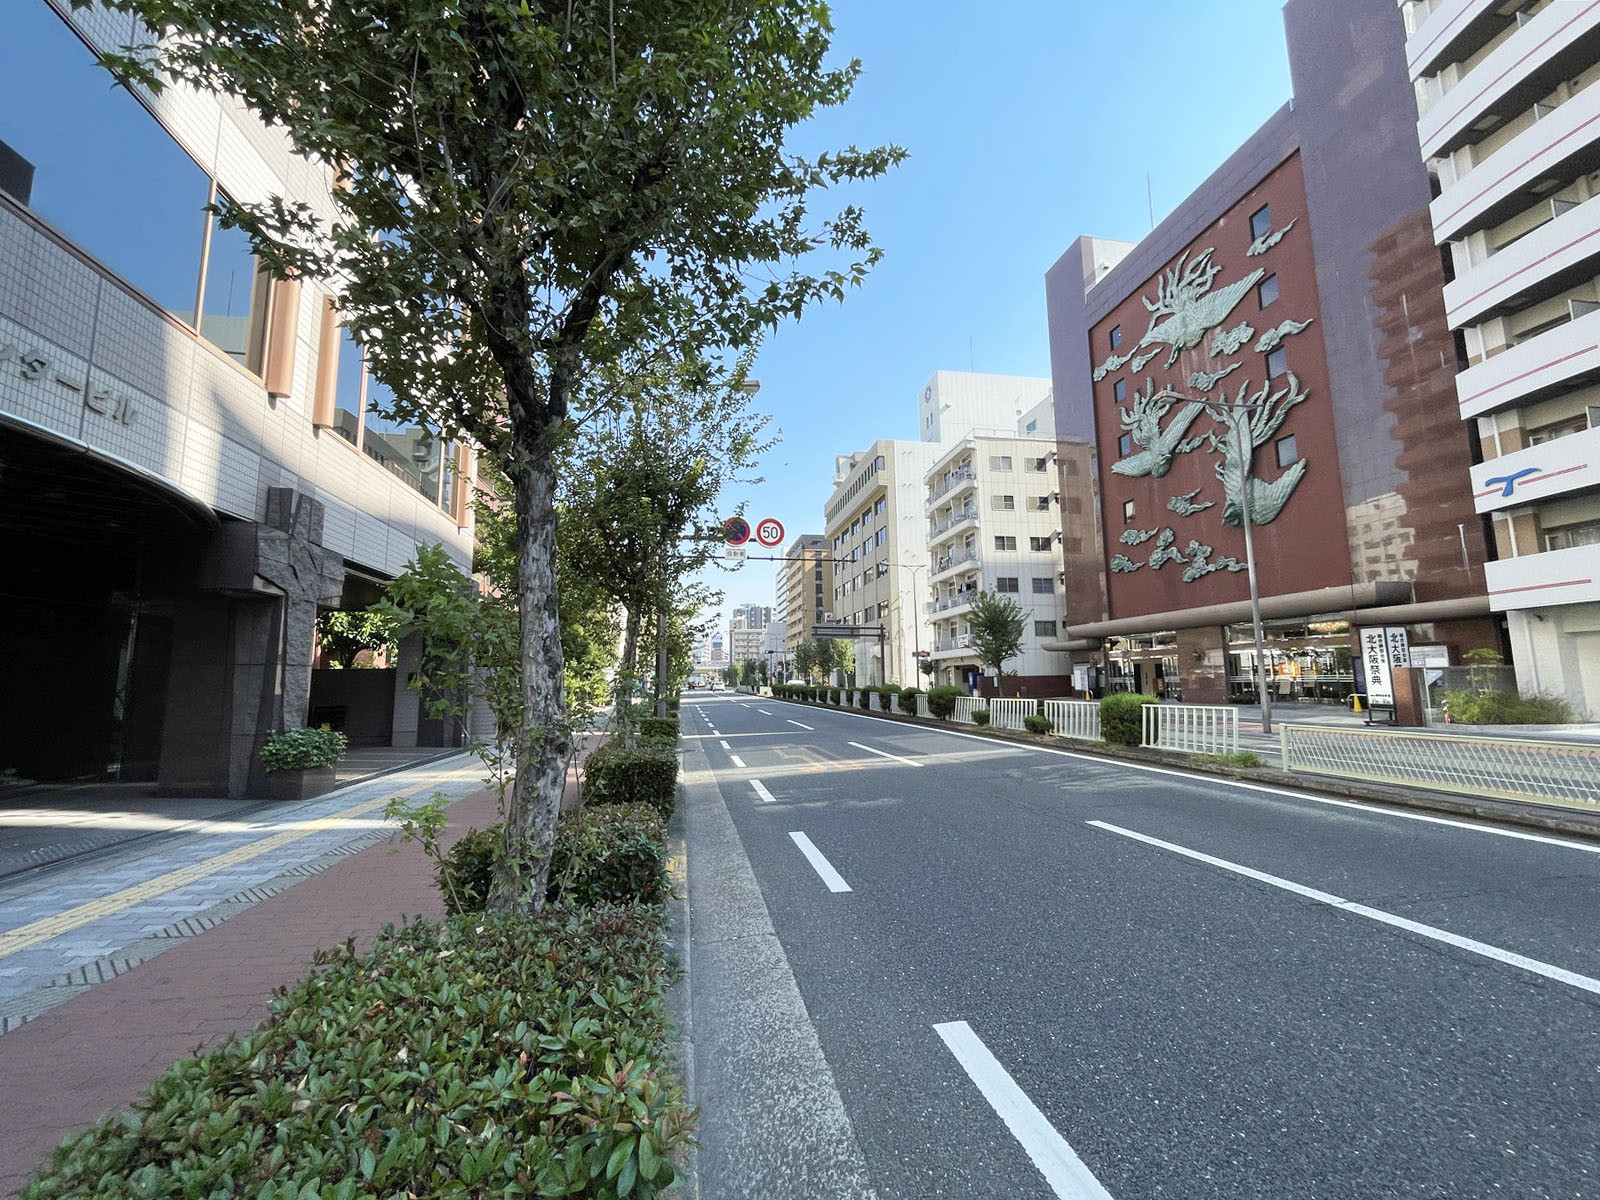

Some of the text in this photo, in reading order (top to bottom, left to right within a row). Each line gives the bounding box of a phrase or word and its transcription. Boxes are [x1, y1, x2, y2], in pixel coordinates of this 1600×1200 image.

[762, 526, 778, 539] 50
[1366, 634, 1382, 685] 北大阪祭典
[1390, 633, 1403, 667] 北大阪
